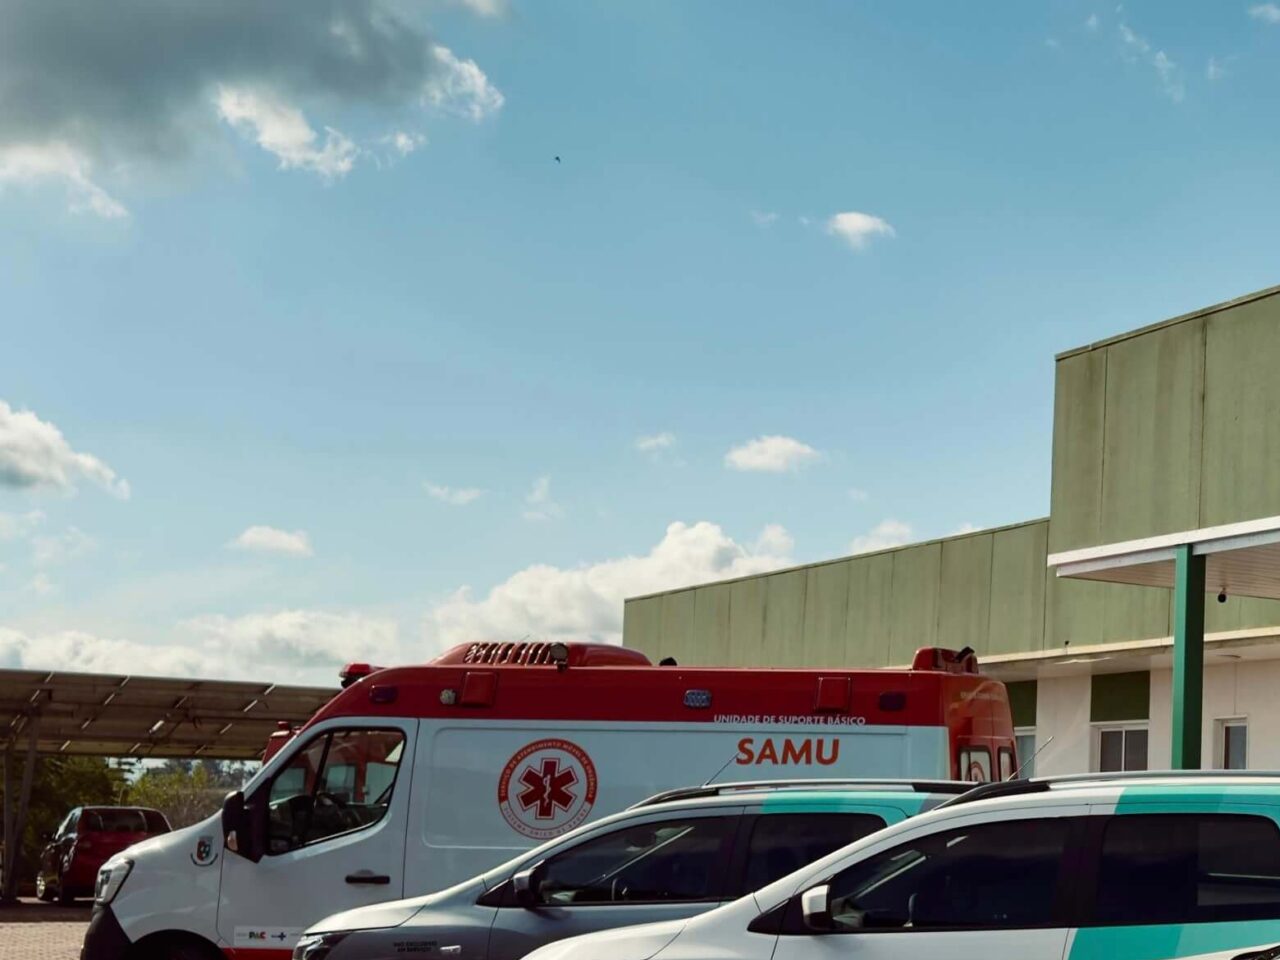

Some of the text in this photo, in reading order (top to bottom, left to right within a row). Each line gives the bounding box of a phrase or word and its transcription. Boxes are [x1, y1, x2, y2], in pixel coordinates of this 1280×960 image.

[713, 714, 866, 726] UNIDADE DE SUPORTE BÁSICO
[736, 737, 840, 765] SAMU
